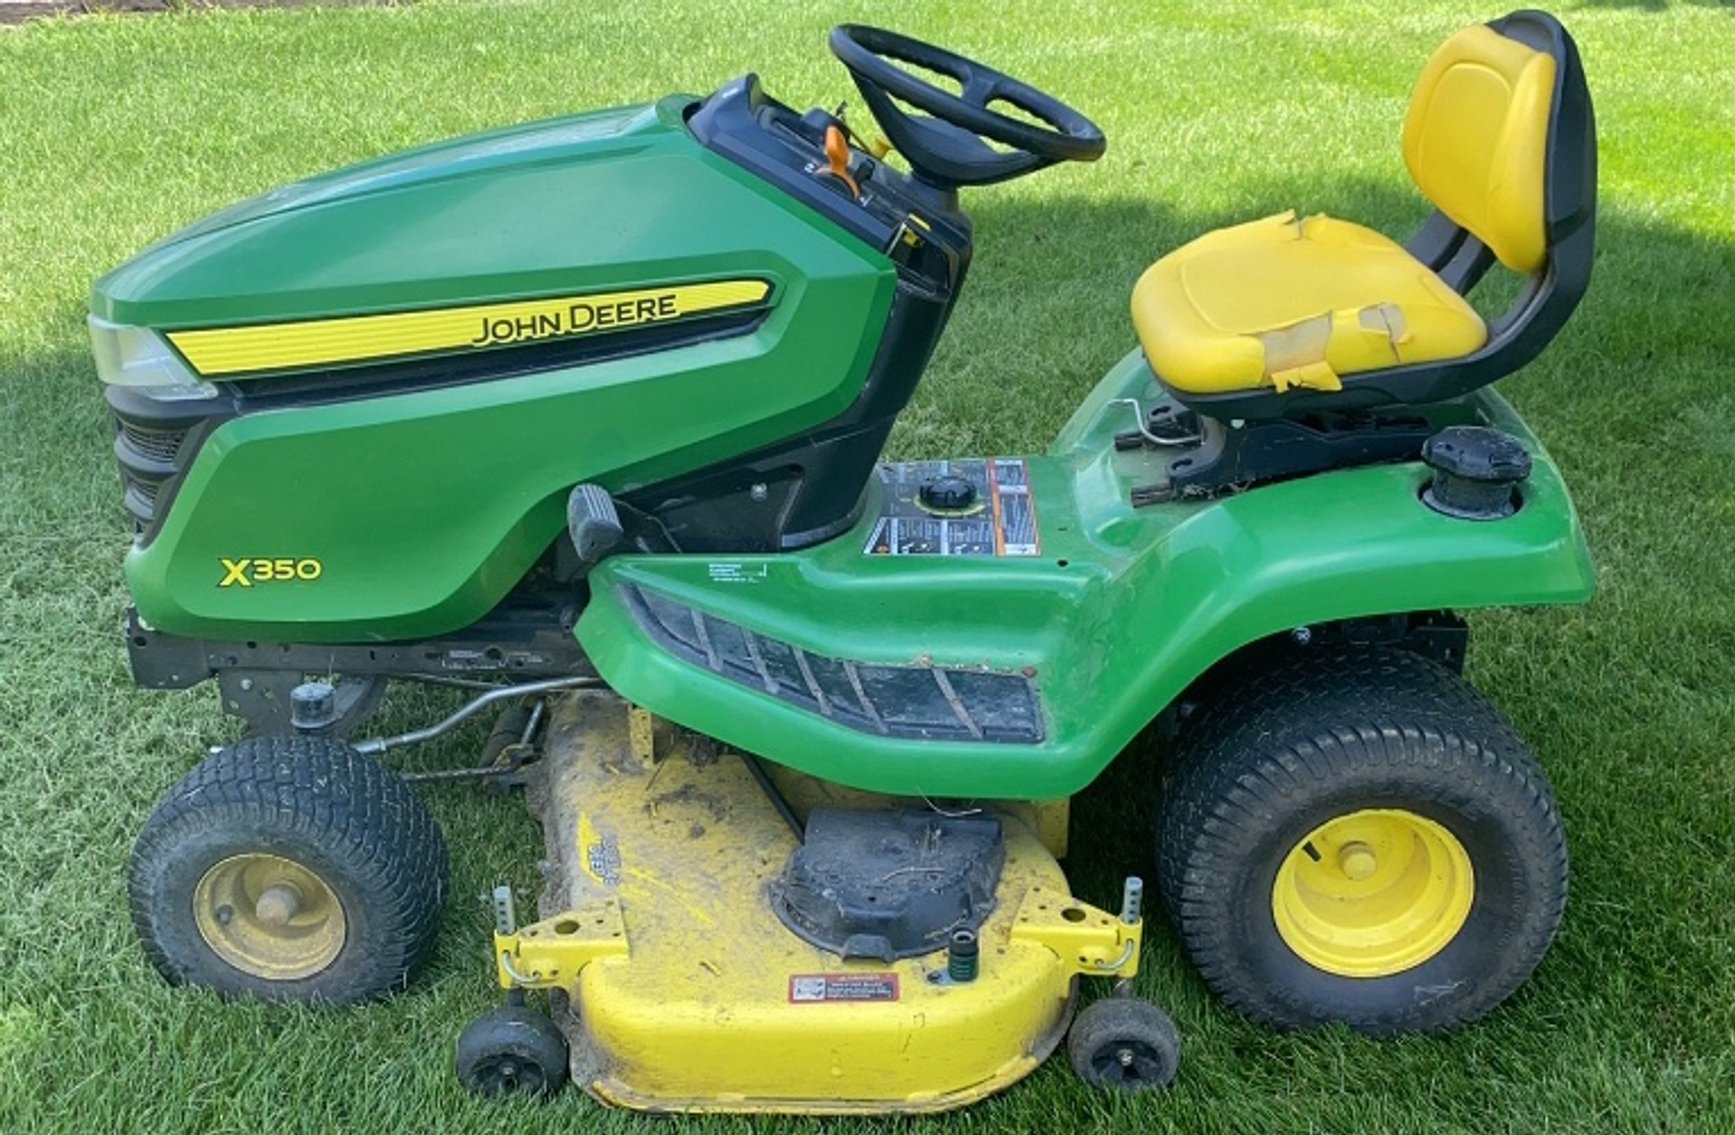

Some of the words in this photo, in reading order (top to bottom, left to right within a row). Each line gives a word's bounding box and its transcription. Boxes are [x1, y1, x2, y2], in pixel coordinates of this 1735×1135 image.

[473, 312, 561, 343] JOHN
[569, 295, 677, 329] DEERE
[218, 558, 323, 588] X350
